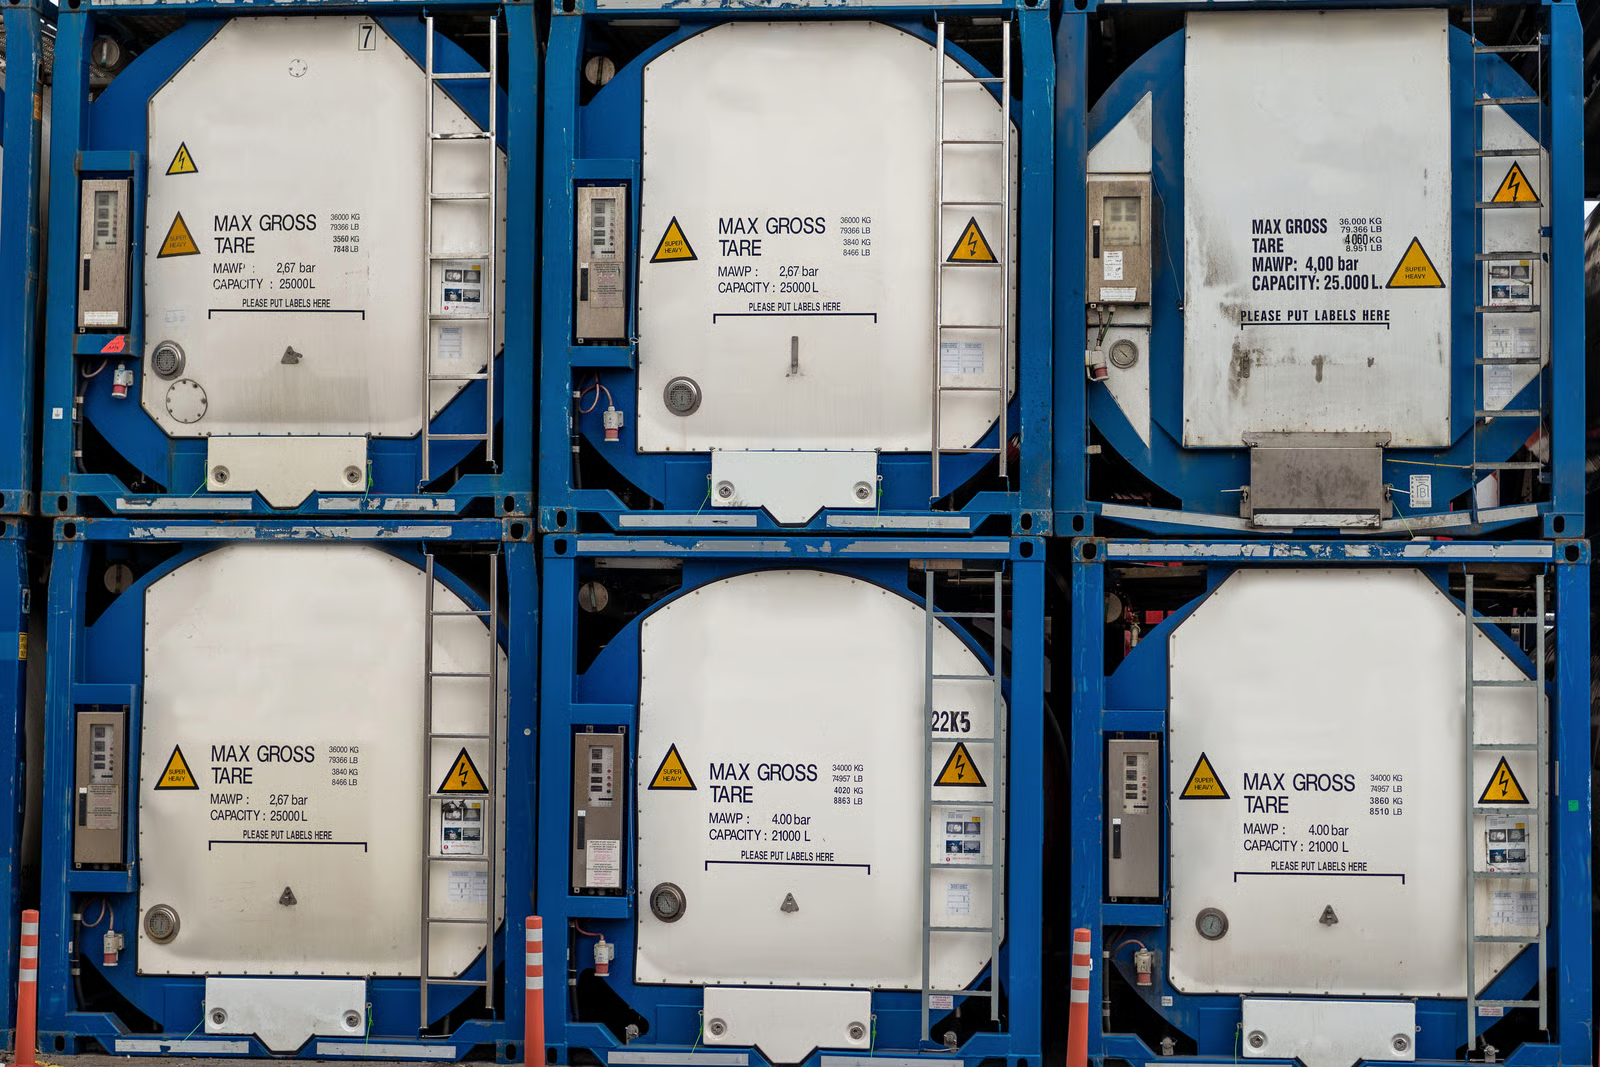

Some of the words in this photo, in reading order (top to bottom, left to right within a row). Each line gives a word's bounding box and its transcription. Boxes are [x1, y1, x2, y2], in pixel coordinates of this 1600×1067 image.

[362, 26, 372, 48] 7
[215, 215, 252, 231] MAX
[260, 214, 316, 231] GROSS
[719, 218, 758, 234] MAX
[766, 217, 825, 234] GROSS
[1252, 219, 1281, 234] MAX
[1286, 218, 1327, 234] GROSS
[214, 237, 255, 253] TARE
[719, 240, 761, 256] TARE
[1252, 238, 1283, 253] TARE
[277, 262, 295, 274] 2,67
[300, 262, 316, 273] bar
[780, 266, 799, 278] 2,67
[802, 266, 819, 276] bar
[1253, 257, 1297, 272] MAWP:
[1306, 256, 1333, 274] 4,00
[1338, 256, 1358, 271] bar
[1253, 275, 1319, 291] CAPACITY:
[243, 299, 267, 307] PLEASE
[270, 299, 283, 307] PUT
[285, 299, 310, 308] LABELS
[313, 299, 330, 307] HERE
[749, 303, 775, 311] PLEASE
[778, 303, 791, 311] PUT
[794, 302, 820, 311] LABELS
[823, 302, 840, 311] HERE
[1240, 309, 1280, 321] PLEASE
[1288, 310, 1308, 321] PUT
[1315, 310, 1355, 321] LABELS
[1363, 310, 1389, 320] HERE
[932, 711, 970, 732] 22K5
[212, 745, 249, 762] MAX
[257, 745, 314, 763] GROSS
[212, 767, 252, 784] TARE
[710, 763, 750, 780] MAX
[758, 764, 817, 781] GROSS
[1244, 773, 1285, 790] MAX
[1293, 774, 1355, 791] GROSS
[270, 794, 289, 806] 2,67
[292, 794, 308, 805] bar
[710, 786, 753, 803] TARE
[1244, 796, 1288, 813] TARE
[772, 814, 792, 824] 4.00
[794, 814, 811, 825] bar
[243, 830, 268, 839] PLEASE
[271, 830, 284, 839] PUT
[287, 831, 312, 839] LABELS
[315, 831, 332, 839] HERE
[772, 830, 800, 841] 21000
[805, 831, 810, 841] L
[1309, 825, 1329, 835] 4.00
[1332, 825, 1349, 836] bar
[1309, 841, 1338, 852] 21000
[1343, 841, 1349, 852] L
[741, 851, 767, 860] PLEASE
[771, 851, 784, 860] PUT
[787, 852, 813, 861] LABELS
[816, 853, 834, 861] HERE
[1271, 861, 1298, 870] PLEASE
[1302, 862, 1315, 870] PUT
[1318, 862, 1345, 871] LABELS
[1349, 862, 1367, 871] HERE
